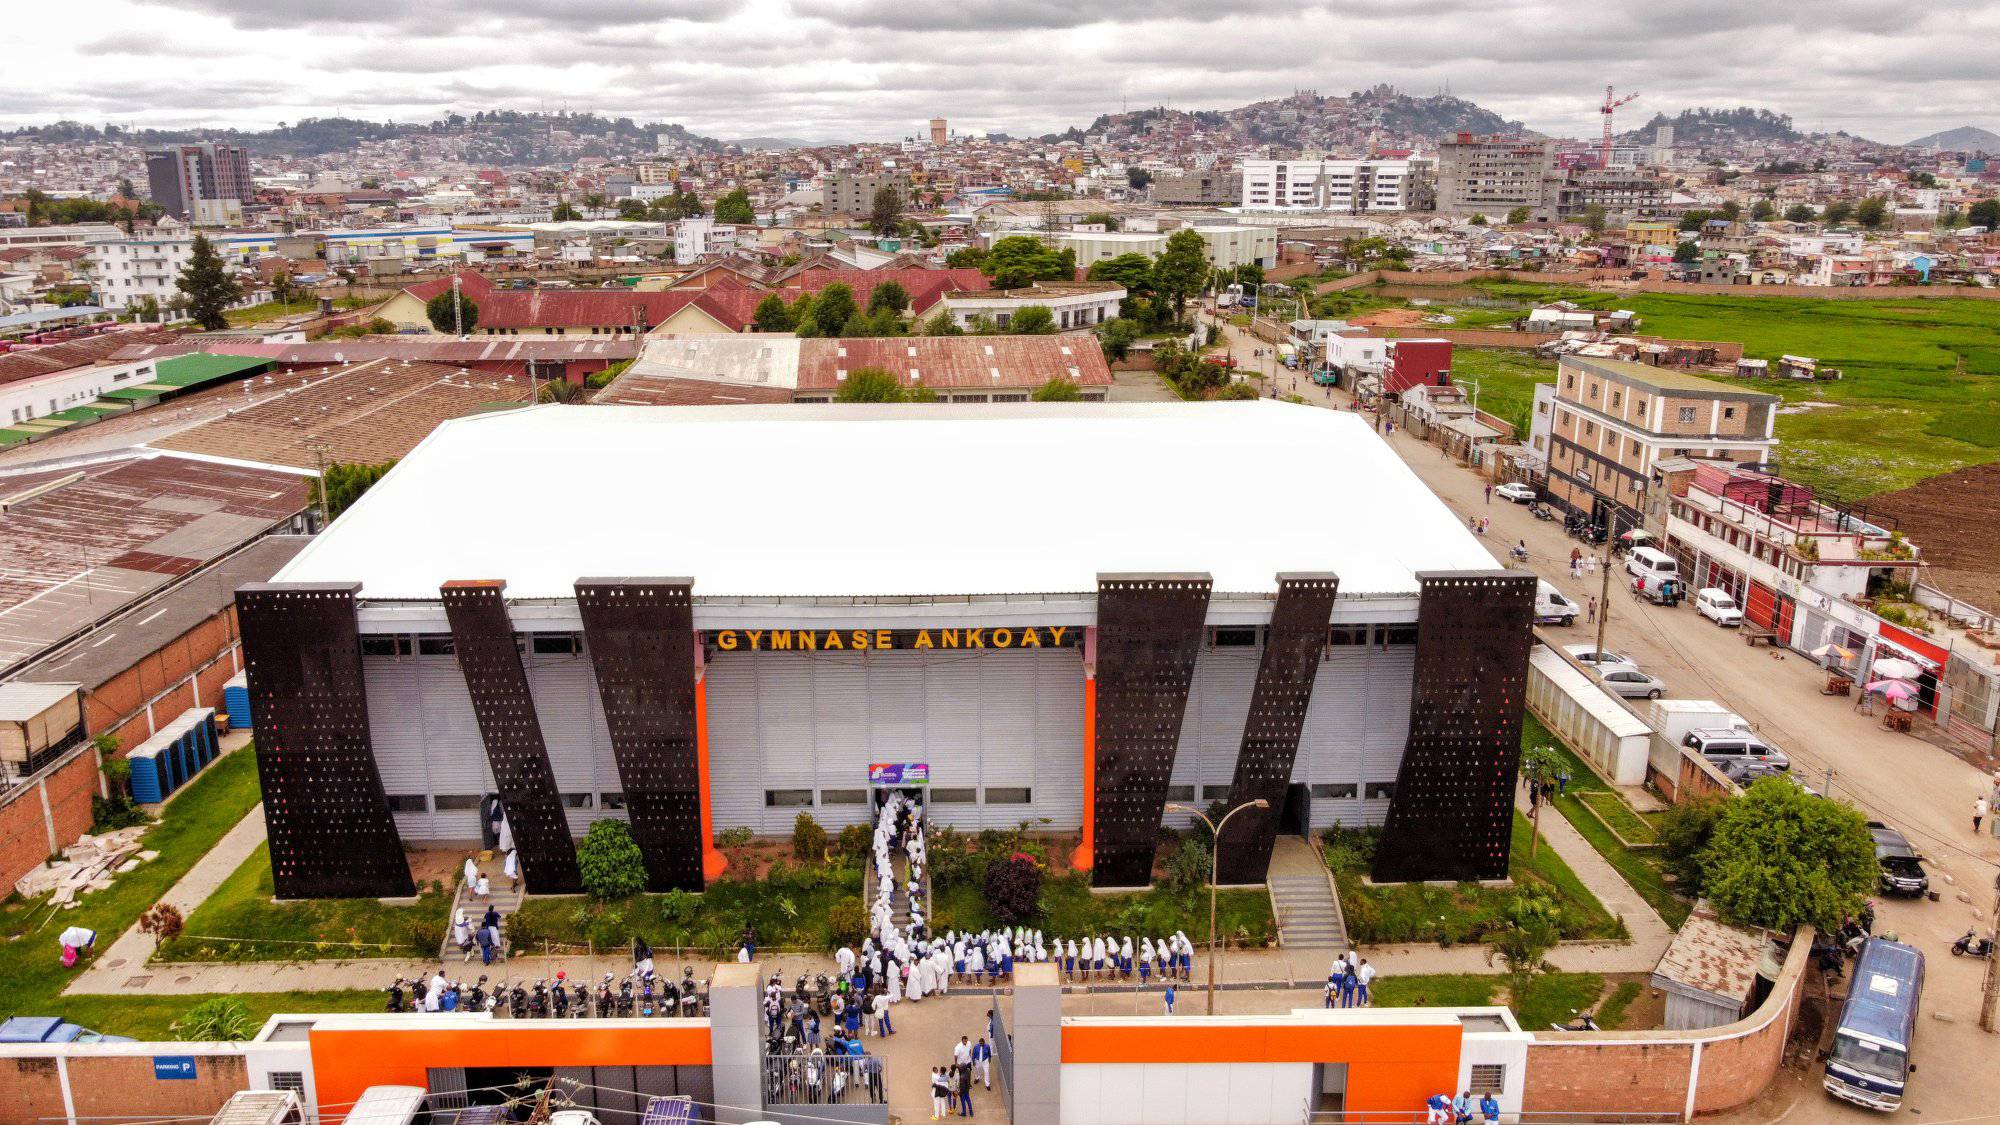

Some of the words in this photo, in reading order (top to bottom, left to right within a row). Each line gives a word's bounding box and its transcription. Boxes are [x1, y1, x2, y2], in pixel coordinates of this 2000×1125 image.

[718, 630, 893, 650] GYMNASE
[914, 627, 1067, 649] ANKOAY
[182, 1062, 190, 1071] P
